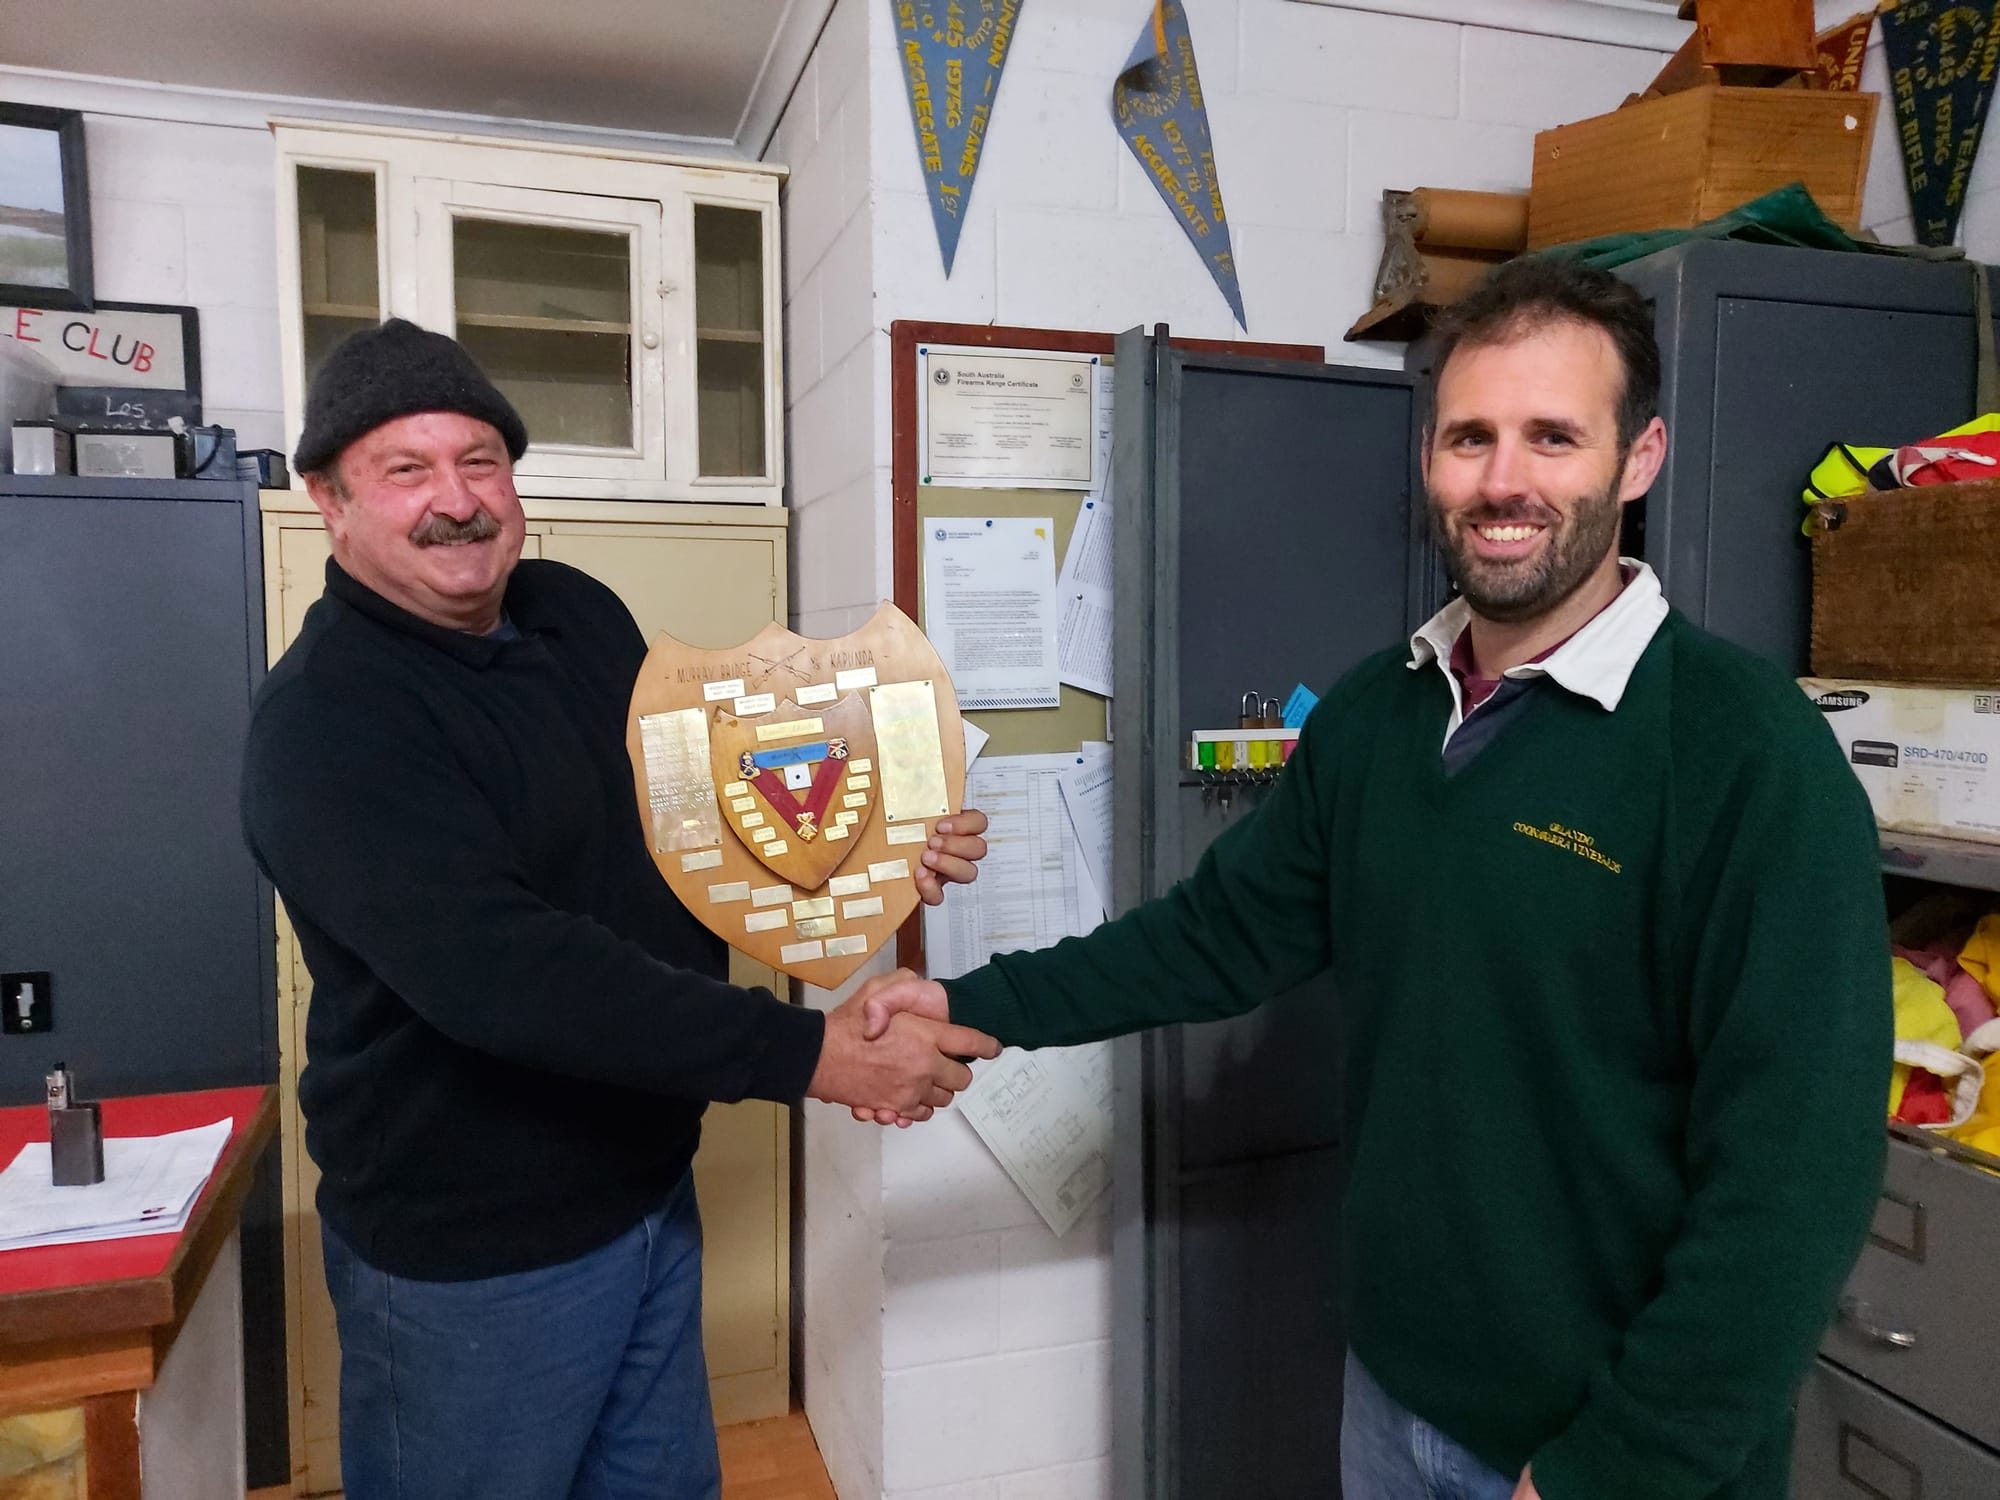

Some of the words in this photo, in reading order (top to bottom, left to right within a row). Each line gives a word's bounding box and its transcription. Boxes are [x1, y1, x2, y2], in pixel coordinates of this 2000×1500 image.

[904, 39, 942, 173] AGGREGATE
[1895, 67, 1916, 114] OFF
[959, 104, 989, 176] TEAMS
[1902, 118, 1929, 192] RIFLE
[1131, 134, 1210, 237] AGGREGATE
[1201, 152, 1226, 222] TEAMS
[62, 321, 155, 373] CLUB
[957, 378, 984, 386] Firearms
[986, 379, 1006, 388] Range
[1007, 380, 1039, 388] Certificate
[977, 371, 1005, 379] Australia
[676, 665, 714, 684] MURRAY
[720, 661, 753, 679] BRIDGE
[830, 649, 875, 668] KAPUNDA
[1815, 695, 1863, 708] SAMSUNG
[1976, 698, 1989, 707] 12
[1903, 746, 1989, 765] SRD-470/470D
